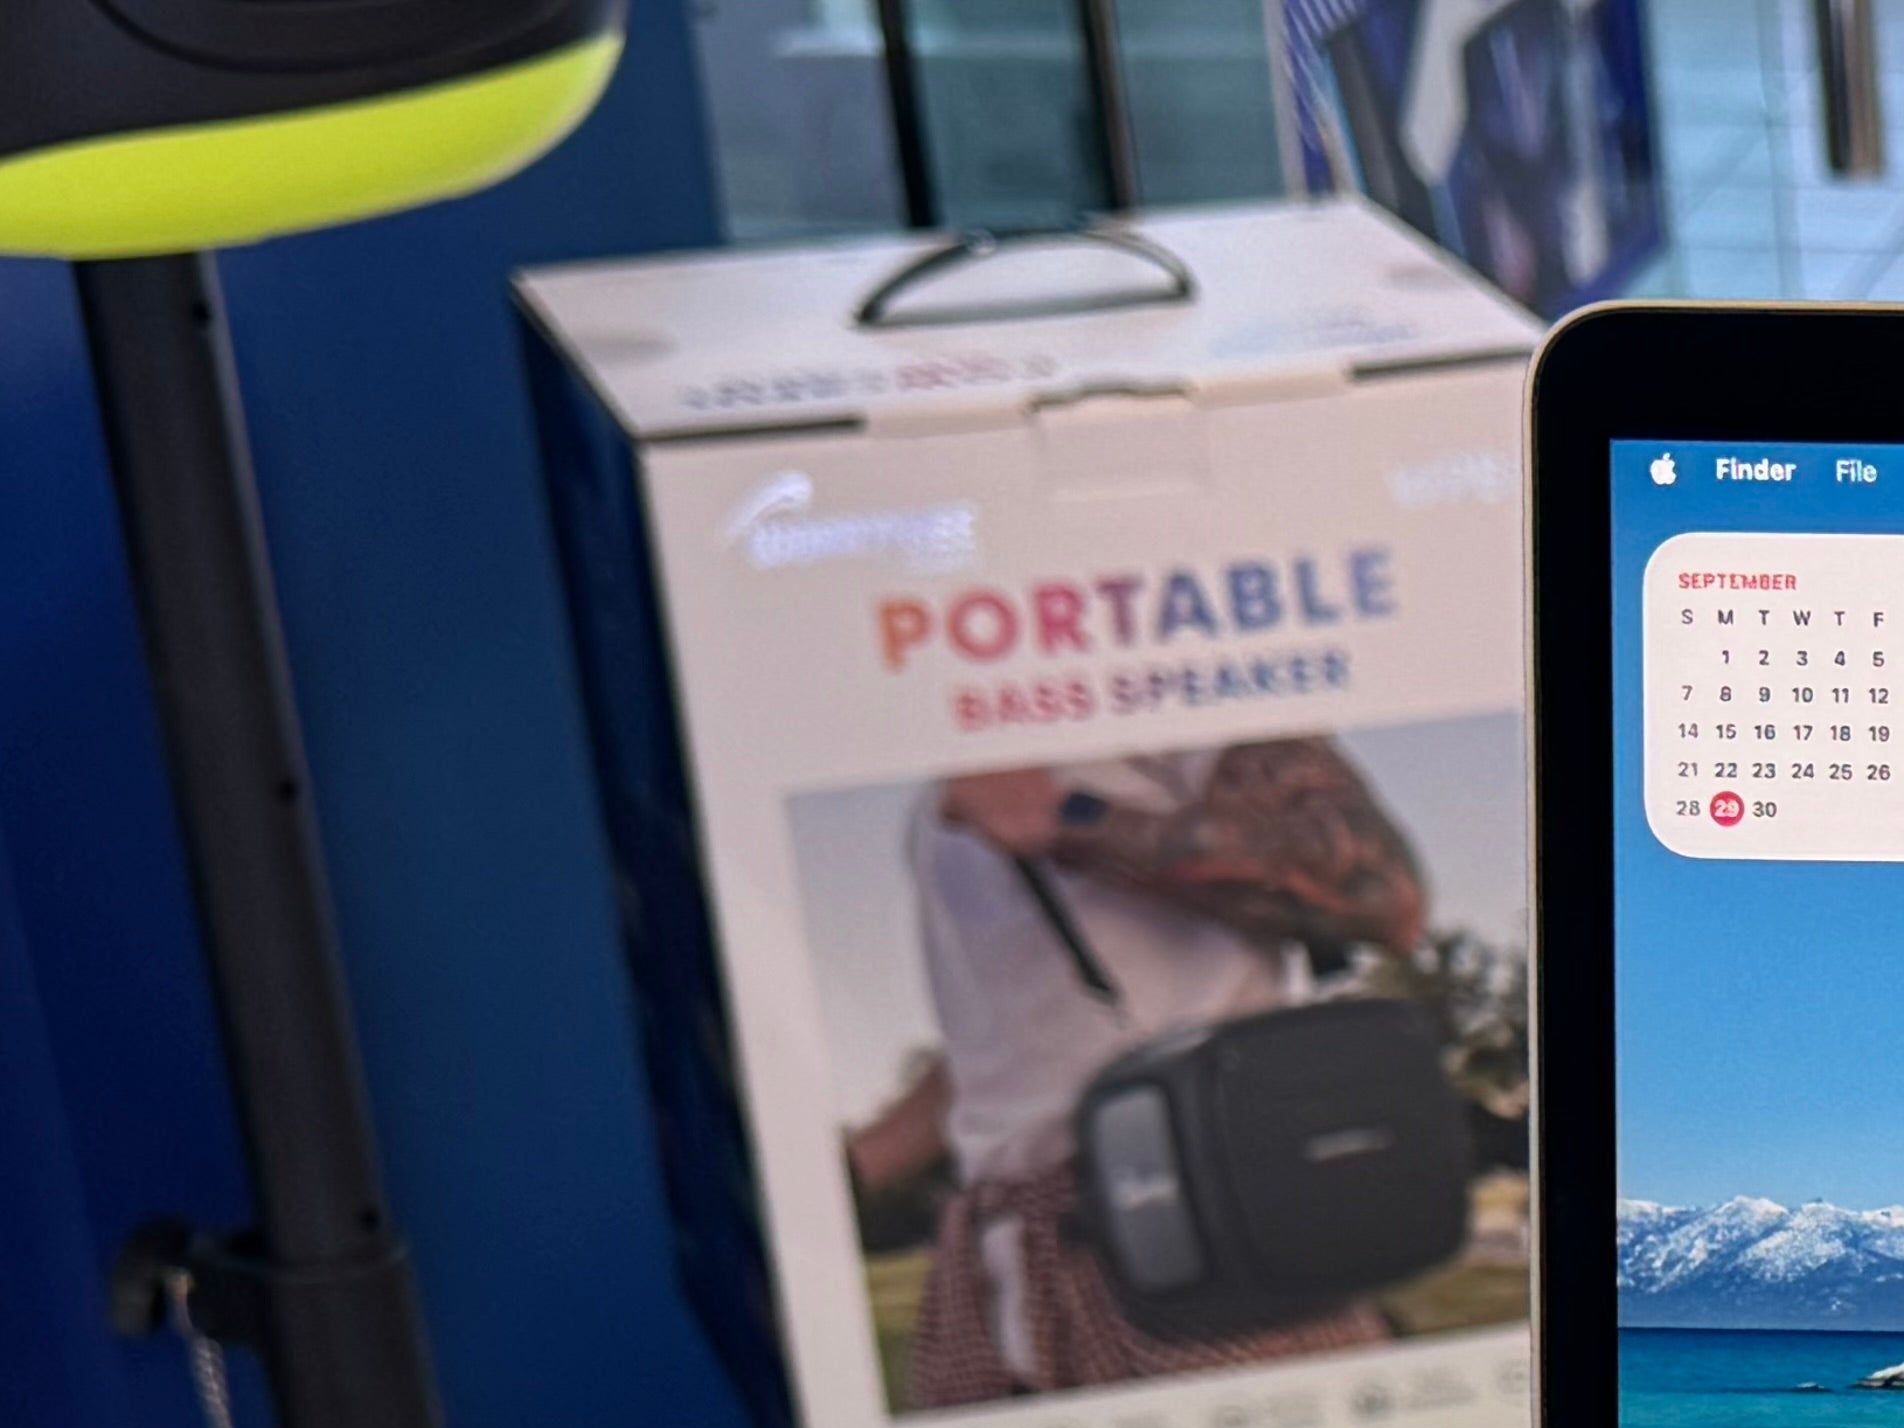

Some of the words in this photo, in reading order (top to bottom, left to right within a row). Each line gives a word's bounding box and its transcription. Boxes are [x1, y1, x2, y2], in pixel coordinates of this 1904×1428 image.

[1716, 457, 1797, 482] Finder
[1836, 459, 1878, 483] File
[1679, 573, 1797, 590] SEPTEMBER
[877, 546, 1394, 673] PORTABLE
[1681, 608, 1694, 625] S
[1717, 609, 1734, 625] M
[1758, 609, 1770, 626] T
[1792, 610, 1811, 627] W
[1833, 610, 1846, 627] T
[1873, 611, 1884, 628] F
[1721, 649, 1730, 665] 1
[1758, 649, 1770, 666] 2
[1796, 650, 1808, 666] 3
[1834, 650, 1846, 667] 4
[1872, 650, 1885, 668] 5
[953, 678, 1096, 731] BASS
[1111, 650, 1352, 712] SPEAKER
[1681, 684, 1693, 701] 7
[1719, 685, 1732, 702] 8
[1758, 686, 1771, 703] 9
[1791, 686, 1814, 703] 10
[1831, 687, 1850, 704] 11
[1868, 687, 1889, 705] 12
[1678, 722, 1699, 739] 14
[1715, 723, 1737, 740] 15
[1753, 724, 1776, 741] 16
[1793, 724, 1813, 741] 17
[1830, 724, 1851, 742] 18
[1868, 725, 1890, 743] 19
[1677, 761, 1698, 778] 21
[1714, 762, 1738, 779] 22
[1752, 762, 1776, 779] 23
[1791, 762, 1815, 780] 24
[1828, 763, 1853, 781] 25
[1866, 764, 1891, 781] 26
[1676, 800, 1701, 817] 28
[1713, 800, 1740, 819] 29
[1752, 800, 1778, 818] 30
